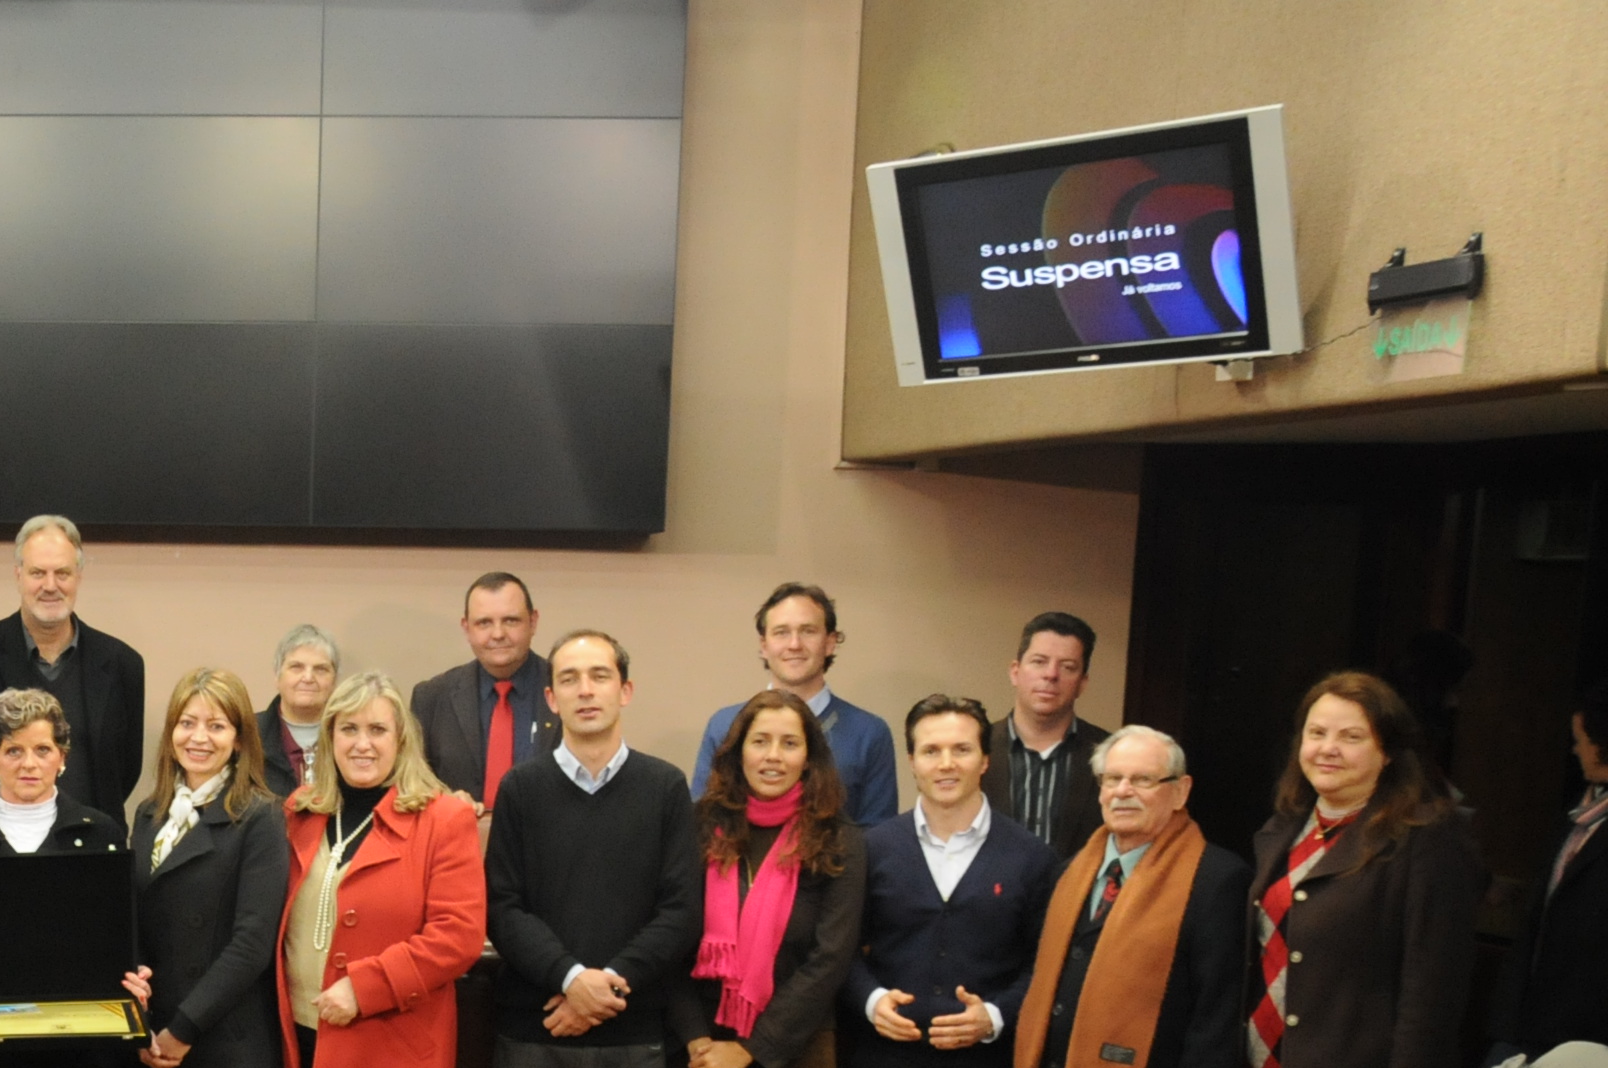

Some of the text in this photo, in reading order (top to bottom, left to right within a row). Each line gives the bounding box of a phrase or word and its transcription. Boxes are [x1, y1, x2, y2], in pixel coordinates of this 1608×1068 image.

[980, 224, 1176, 257] Sessão Ordinária
[981, 252, 1181, 291] Suspensa
